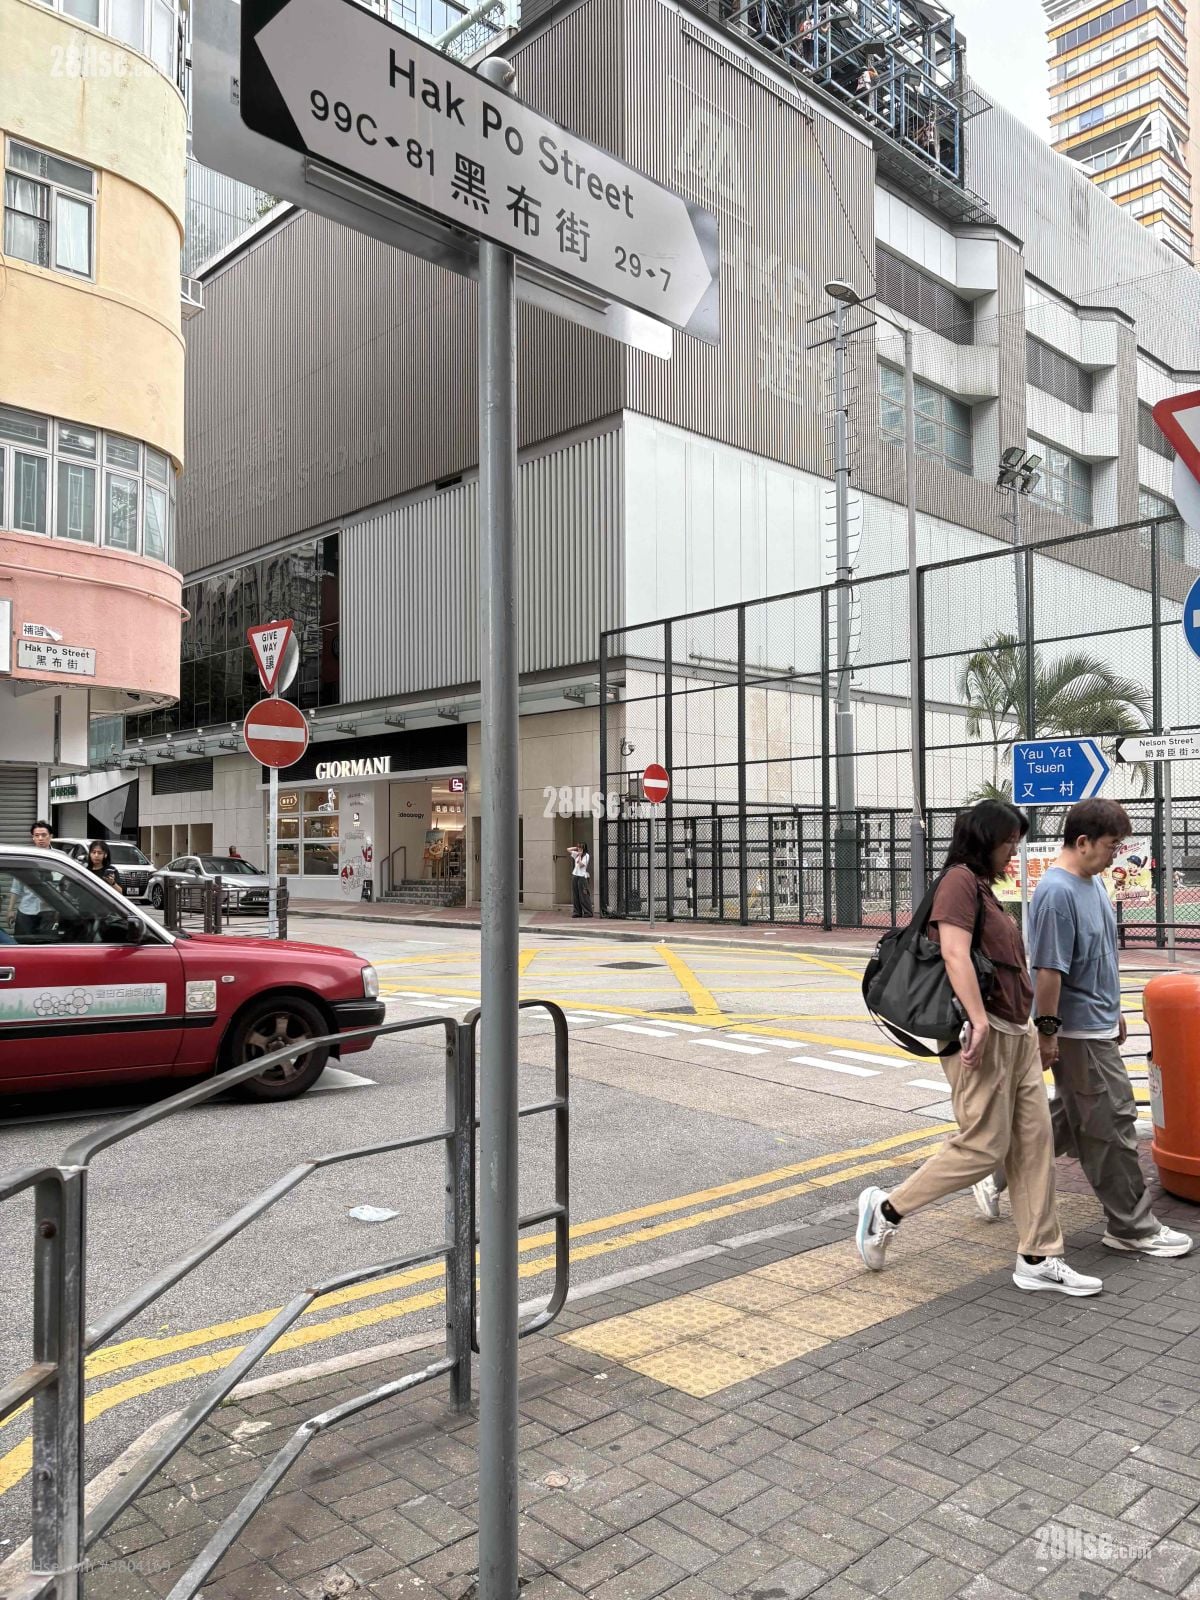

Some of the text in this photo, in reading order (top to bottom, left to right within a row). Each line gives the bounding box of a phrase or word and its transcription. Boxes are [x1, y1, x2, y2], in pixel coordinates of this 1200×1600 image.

[389, 47, 634, 219] Hak Po Street
[450, 151, 591, 263] 黑布街
[24, 624, 52, 637] 補習
[262, 631, 278, 642] GIVE
[25, 643, 90, 659] Hak Po Street
[262, 642, 278, 653] WAY
[36, 654, 79, 670] 黑布街
[1139, 737, 1194, 747] Nelson Street
[1020, 746, 1072, 760] Yau Yat
[1144, 747, 1188, 759] 奶路臣街
[315, 755, 392, 780] GIORMANI
[1026, 762, 1065, 774] Tsuen
[1021, 780, 1074, 798] 又一村
